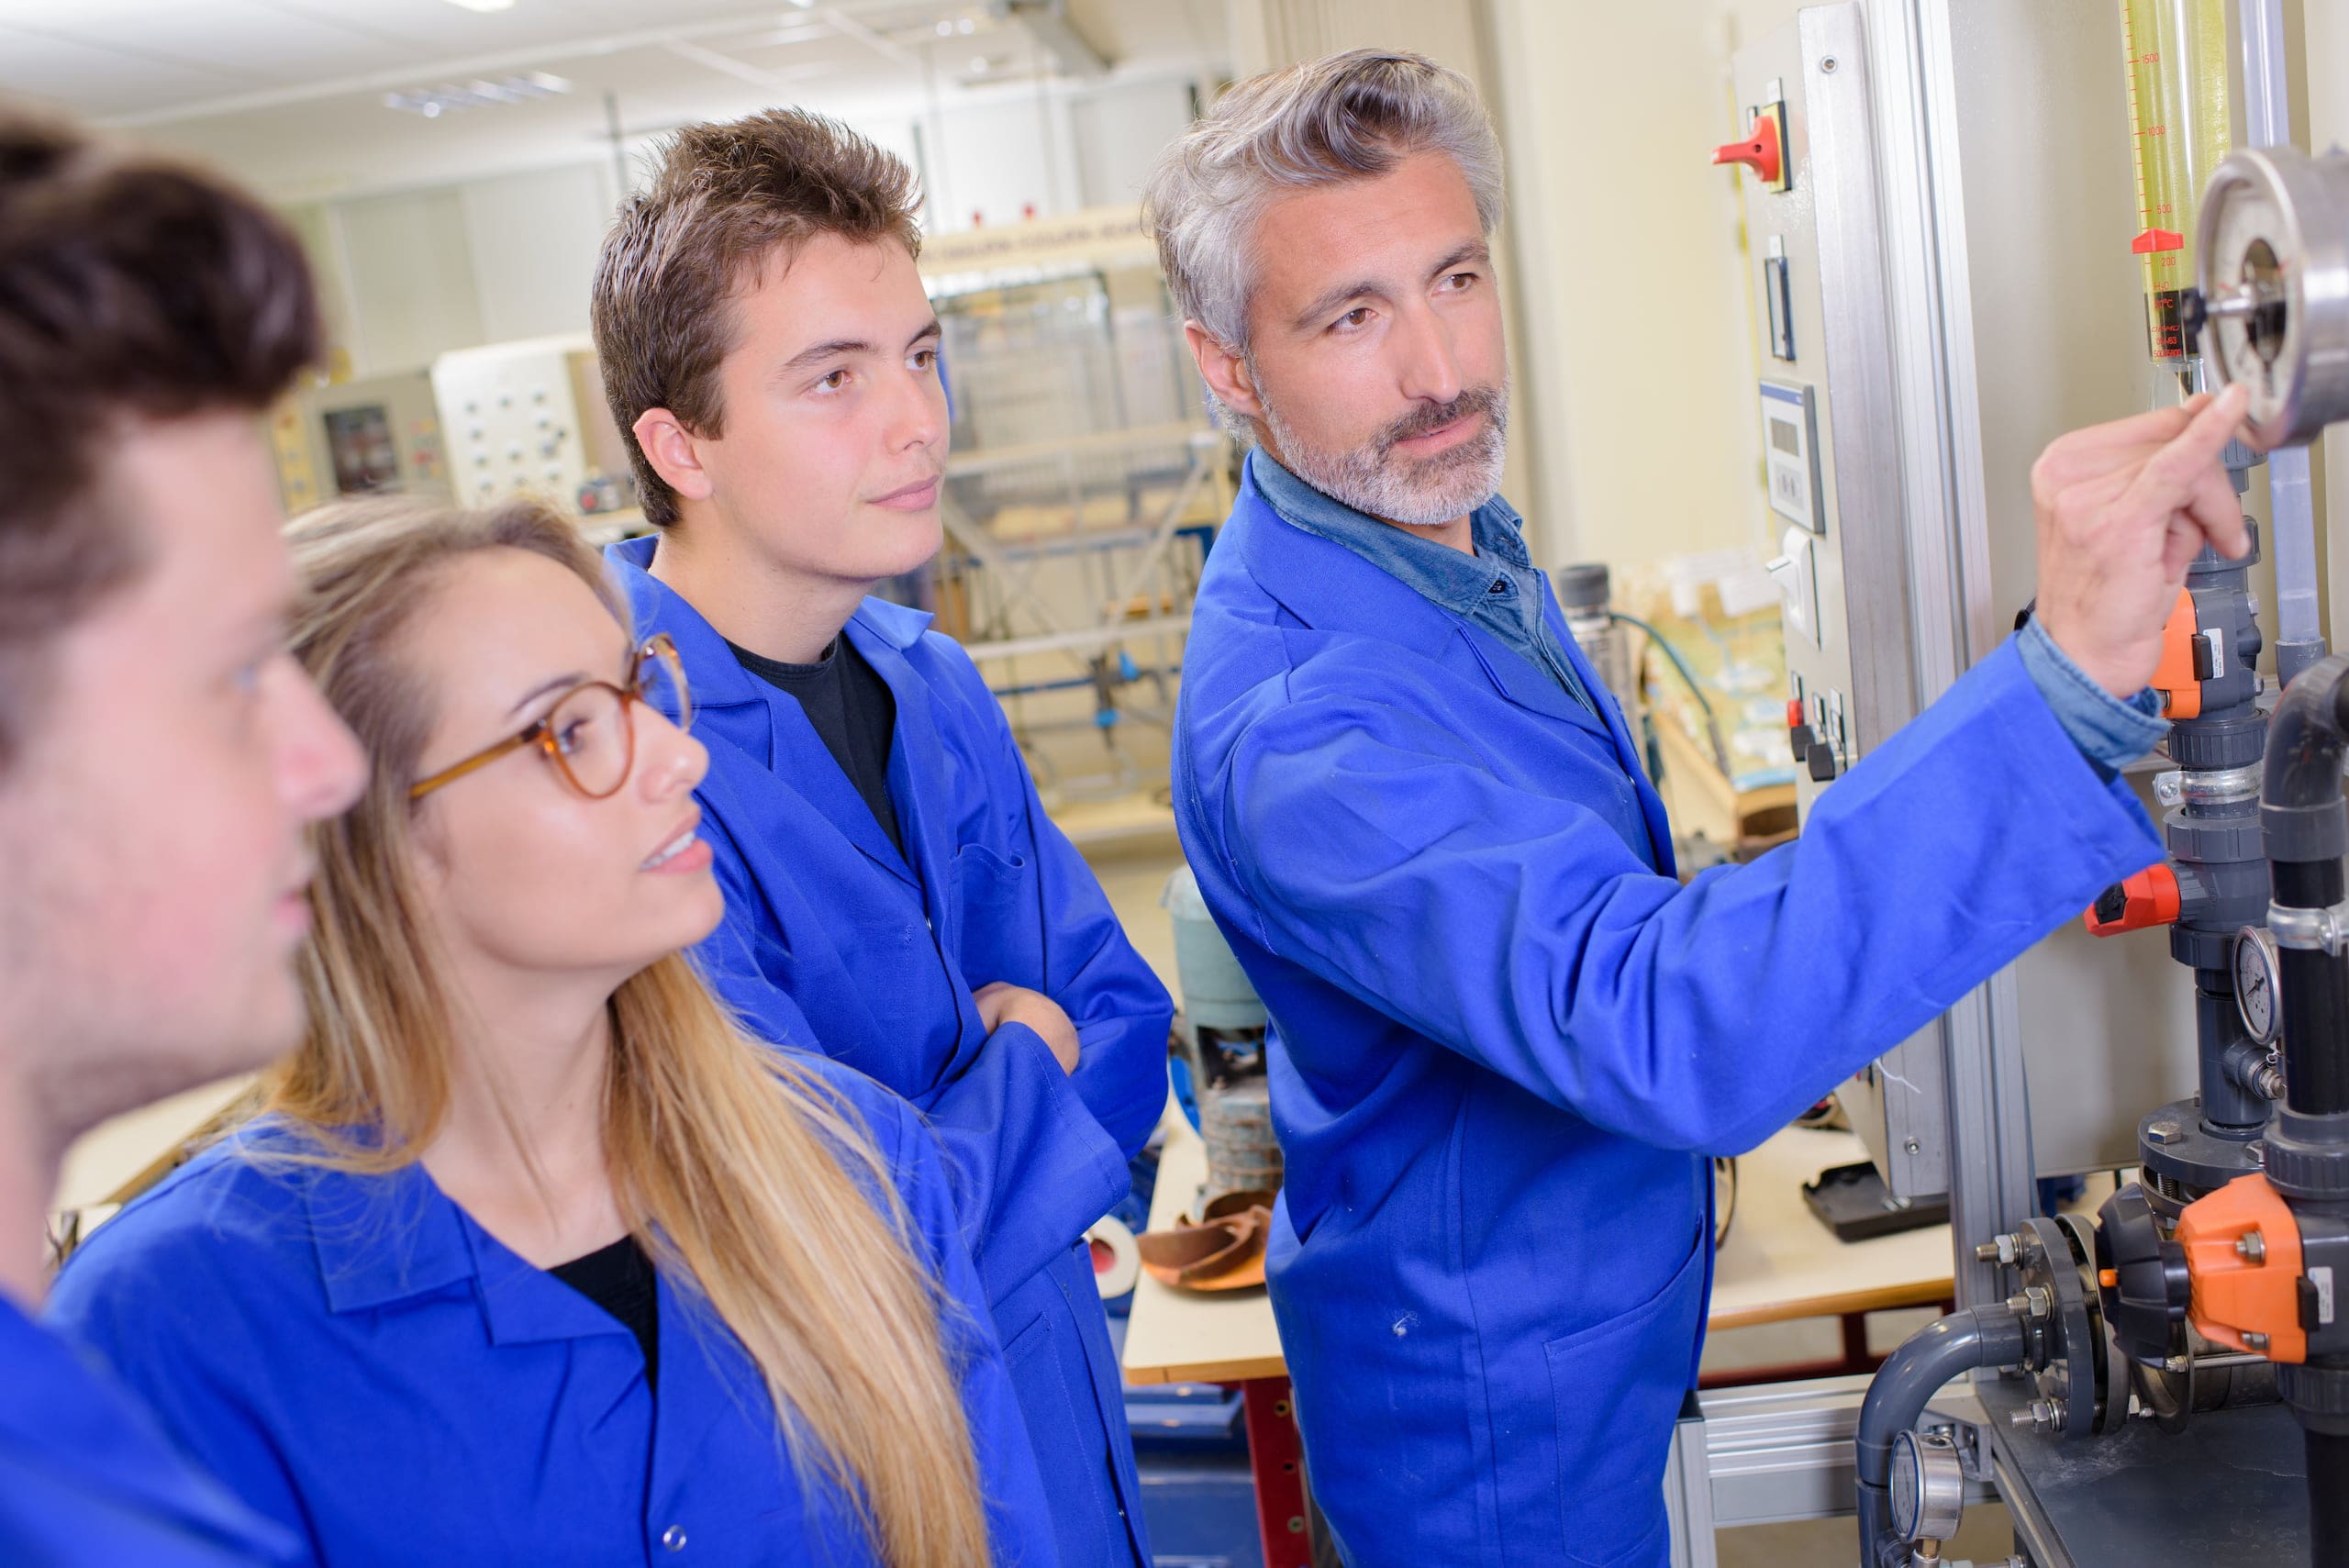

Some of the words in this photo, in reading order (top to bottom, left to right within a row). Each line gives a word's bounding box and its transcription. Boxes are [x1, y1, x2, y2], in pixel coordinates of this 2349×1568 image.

[2143, 53, 2159, 64] 1500
[2148, 126, 2165, 137] 1000
[2161, 256, 2176, 267] 200
